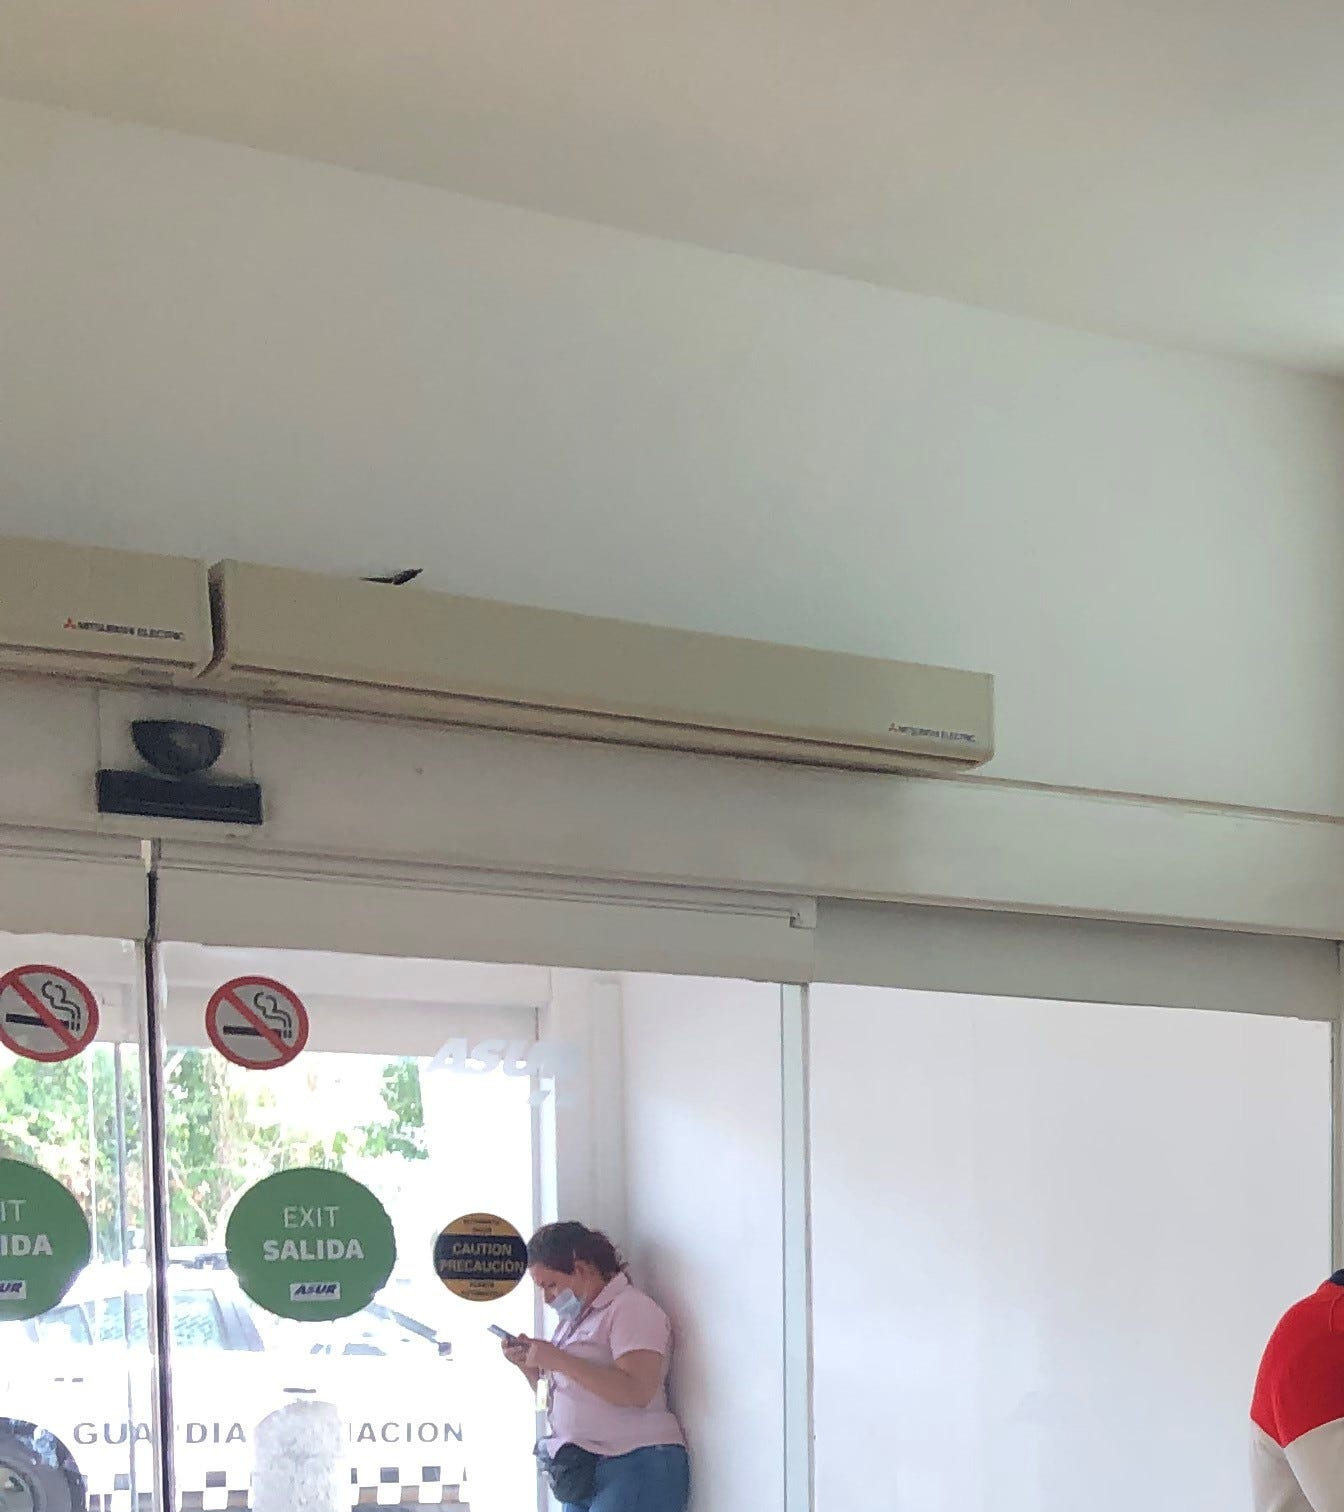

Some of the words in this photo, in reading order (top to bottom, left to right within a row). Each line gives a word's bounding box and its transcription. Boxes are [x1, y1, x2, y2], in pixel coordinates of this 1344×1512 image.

[0, 1200, 27, 1222] IT
[284, 1206, 339, 1228] EXIT
[0, 1233, 53, 1256] IDA
[263, 1238, 364, 1262] SALIDA
[453, 1242, 512, 1256] CAUTION
[73, 1421, 247, 1445] GUADIA
[350, 1421, 464, 1444] ACION
